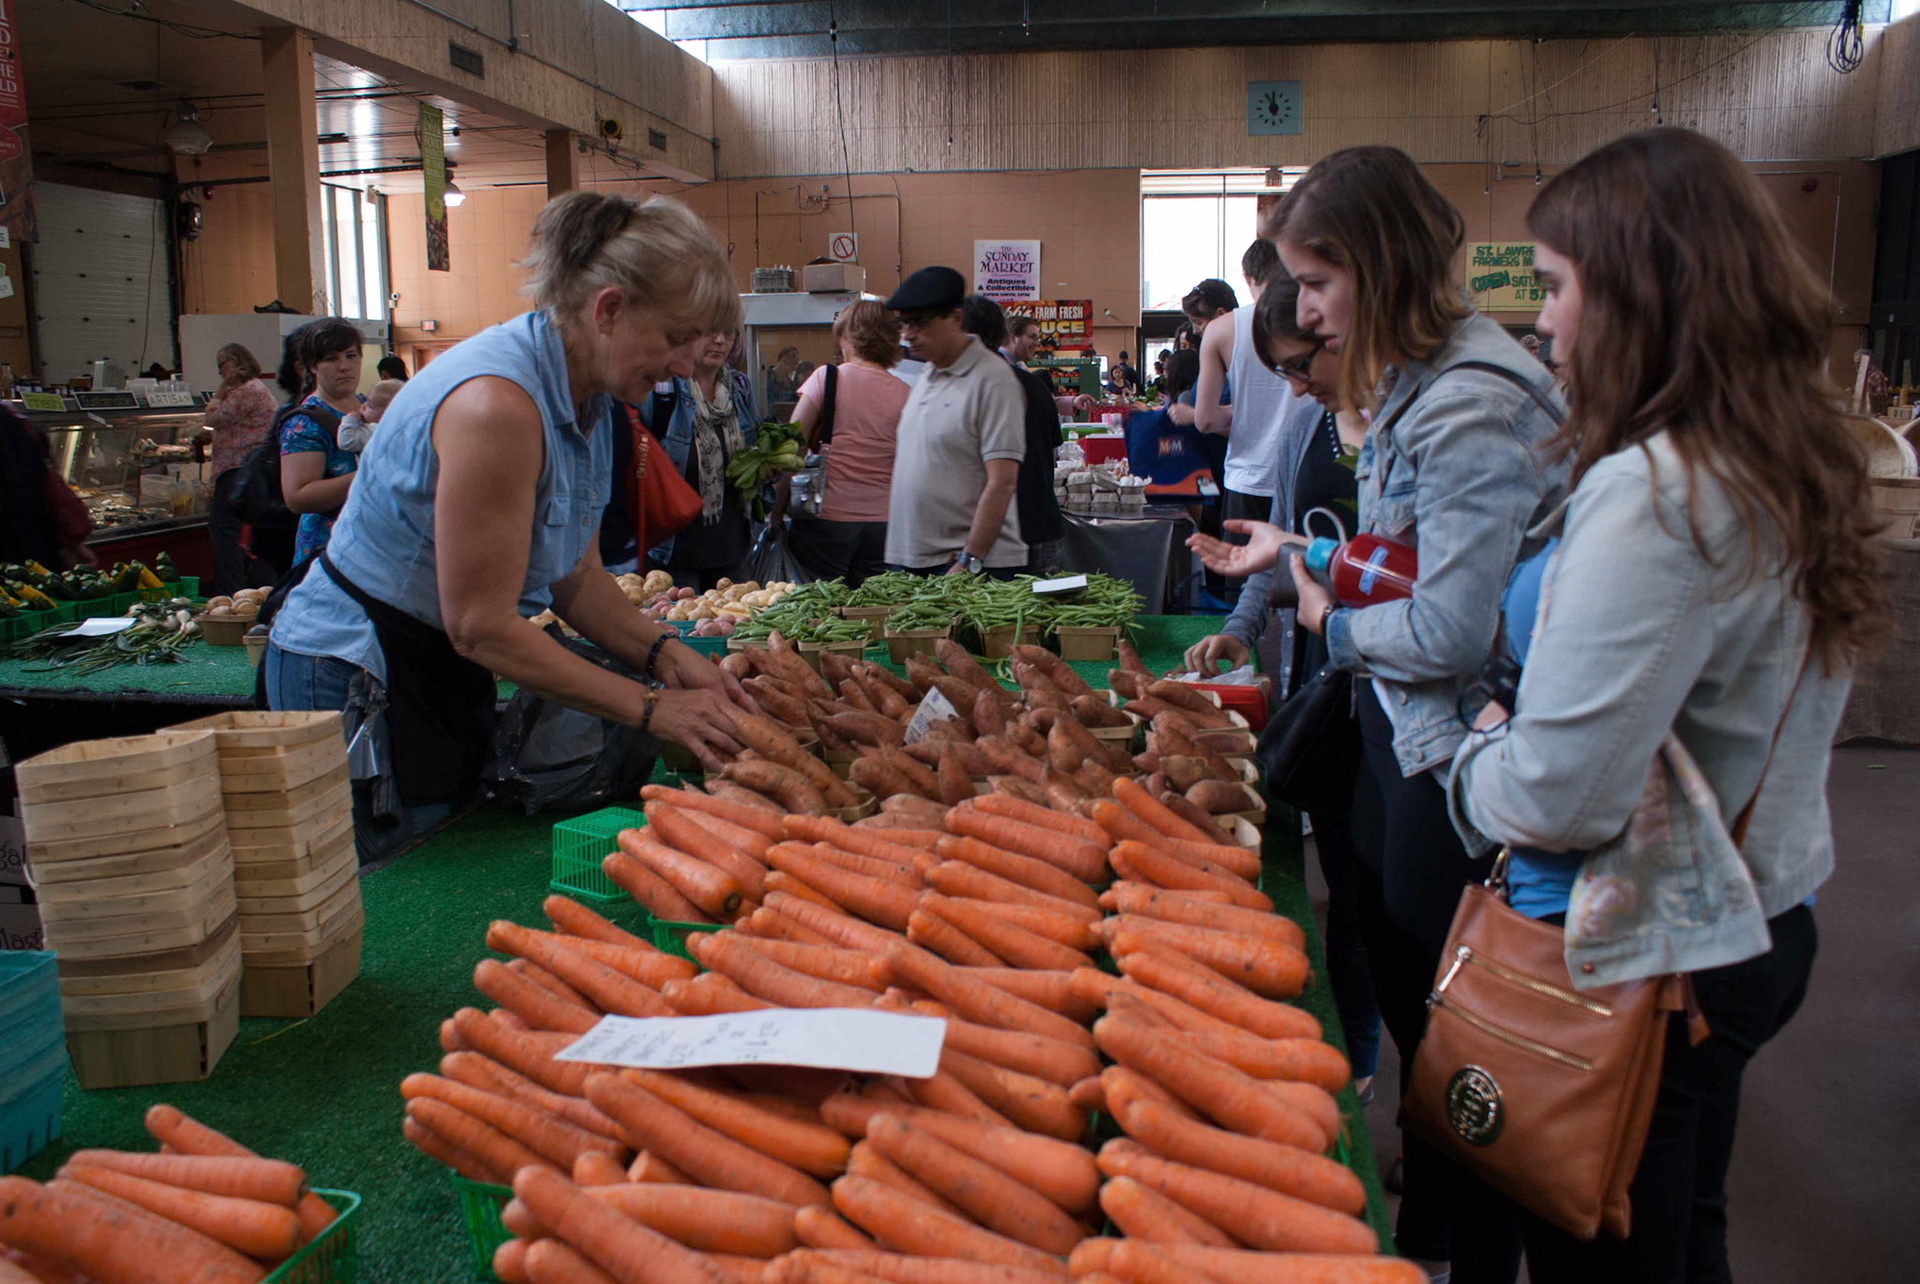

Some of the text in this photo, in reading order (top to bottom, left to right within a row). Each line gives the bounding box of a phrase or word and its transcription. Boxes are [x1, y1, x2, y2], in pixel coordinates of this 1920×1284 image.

[985, 251, 1029, 261] SUNDAY
[1497, 246, 1534, 256] LAWRE
[980, 261, 1034, 273] MARKET
[1472, 257, 1520, 266] FARMERS
[1471, 269, 1510, 293] OPEN
[1515, 289, 1527, 300] AT
[1035, 306, 1057, 319] FARM
[1059, 306, 1083, 319] FRESH
[1040, 321, 1085, 334] UCE
[150, 392, 191, 404] ARTISAN
